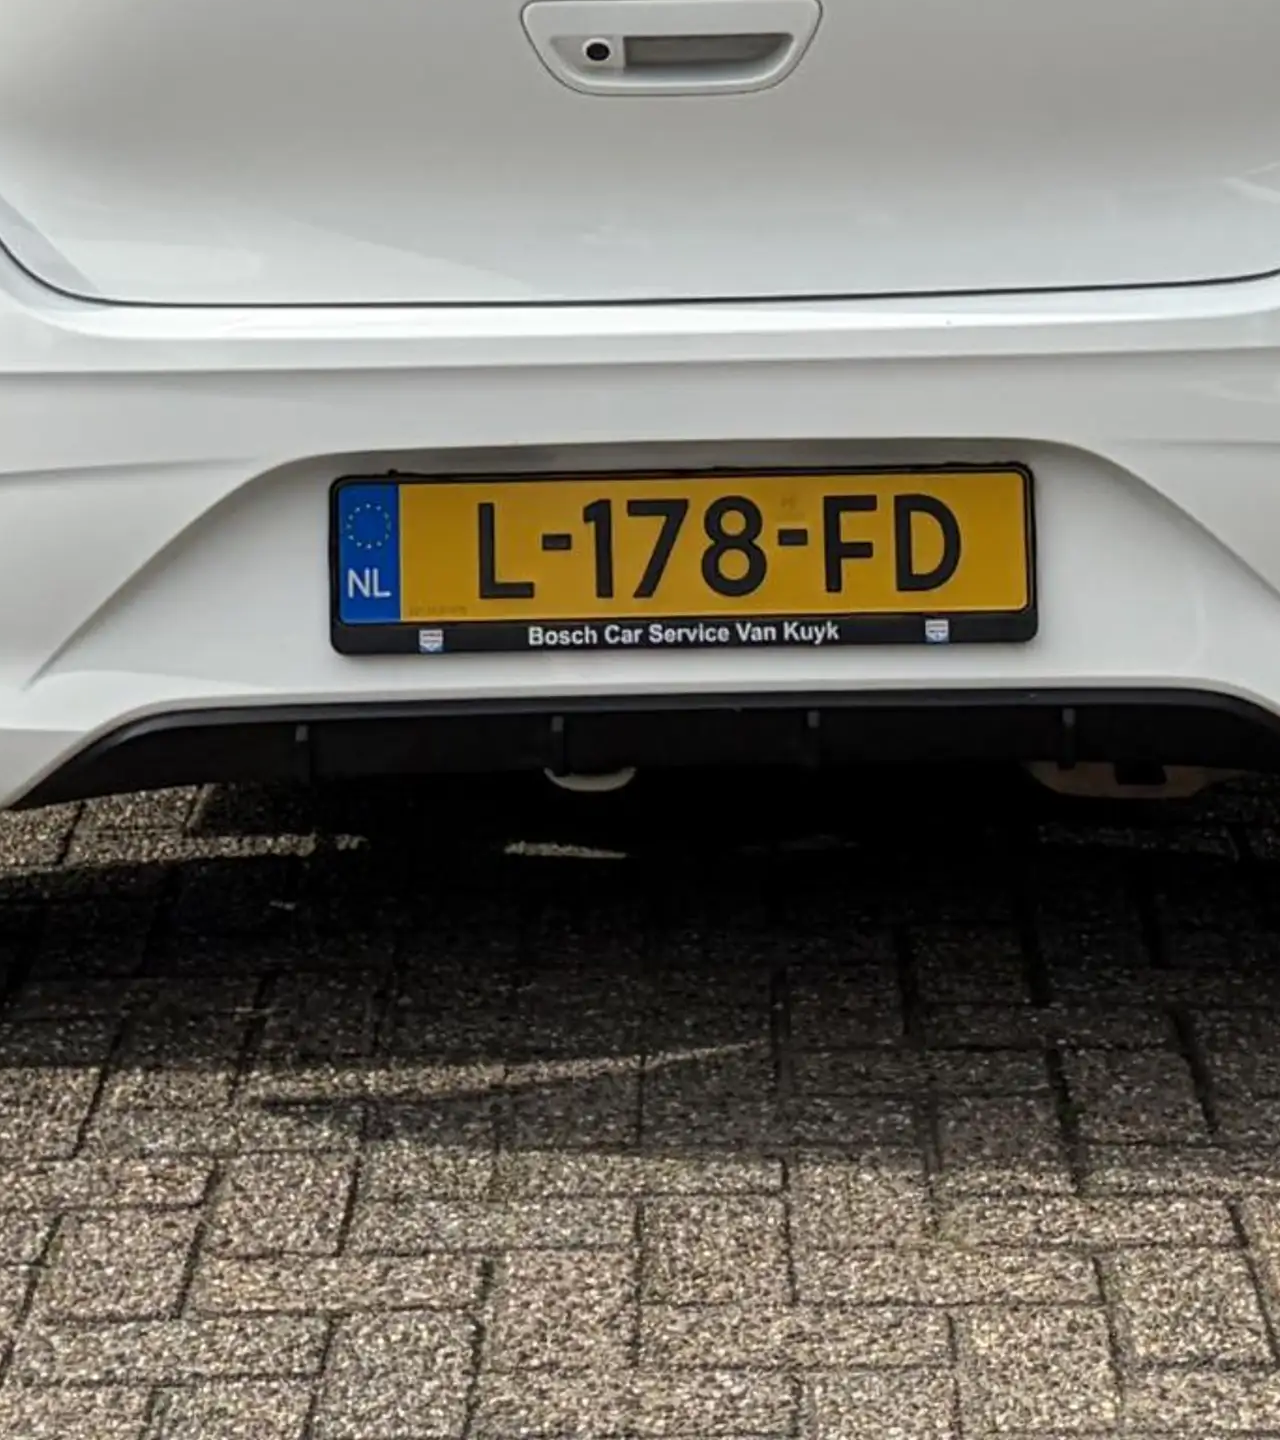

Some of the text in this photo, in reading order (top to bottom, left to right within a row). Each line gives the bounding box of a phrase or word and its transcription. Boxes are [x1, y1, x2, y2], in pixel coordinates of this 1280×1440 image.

[477, 493, 962, 601] L-178-FD
[347, 569, 391, 600] NL
[528, 621, 840, 647] Bosch Car Service Van Kuyk
